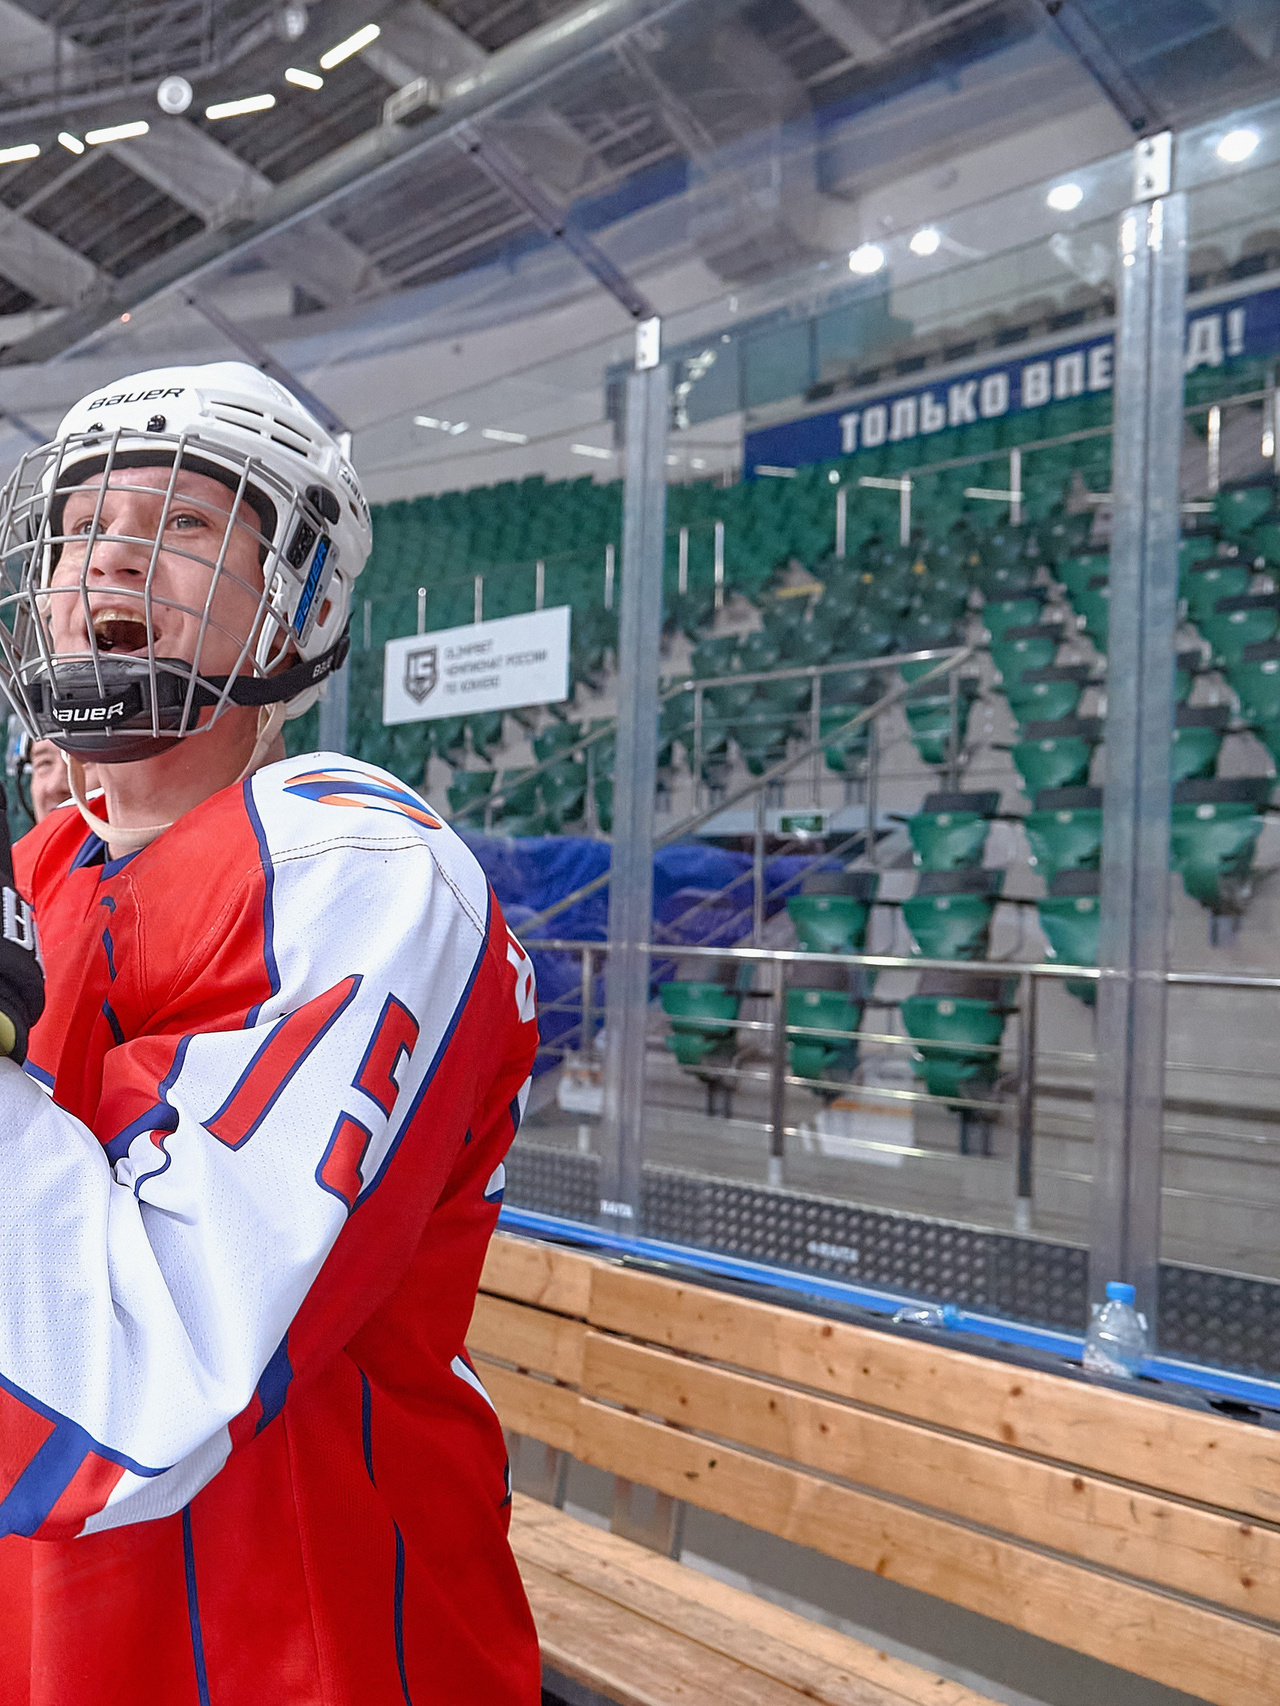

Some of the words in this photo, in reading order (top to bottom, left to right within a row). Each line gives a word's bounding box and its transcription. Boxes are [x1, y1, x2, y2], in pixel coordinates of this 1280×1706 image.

[87, 388, 185, 411] BAUER
[839, 372, 1010, 454] ТОЛЬКО
[1023, 308, 1247, 409] ВПЕД!
